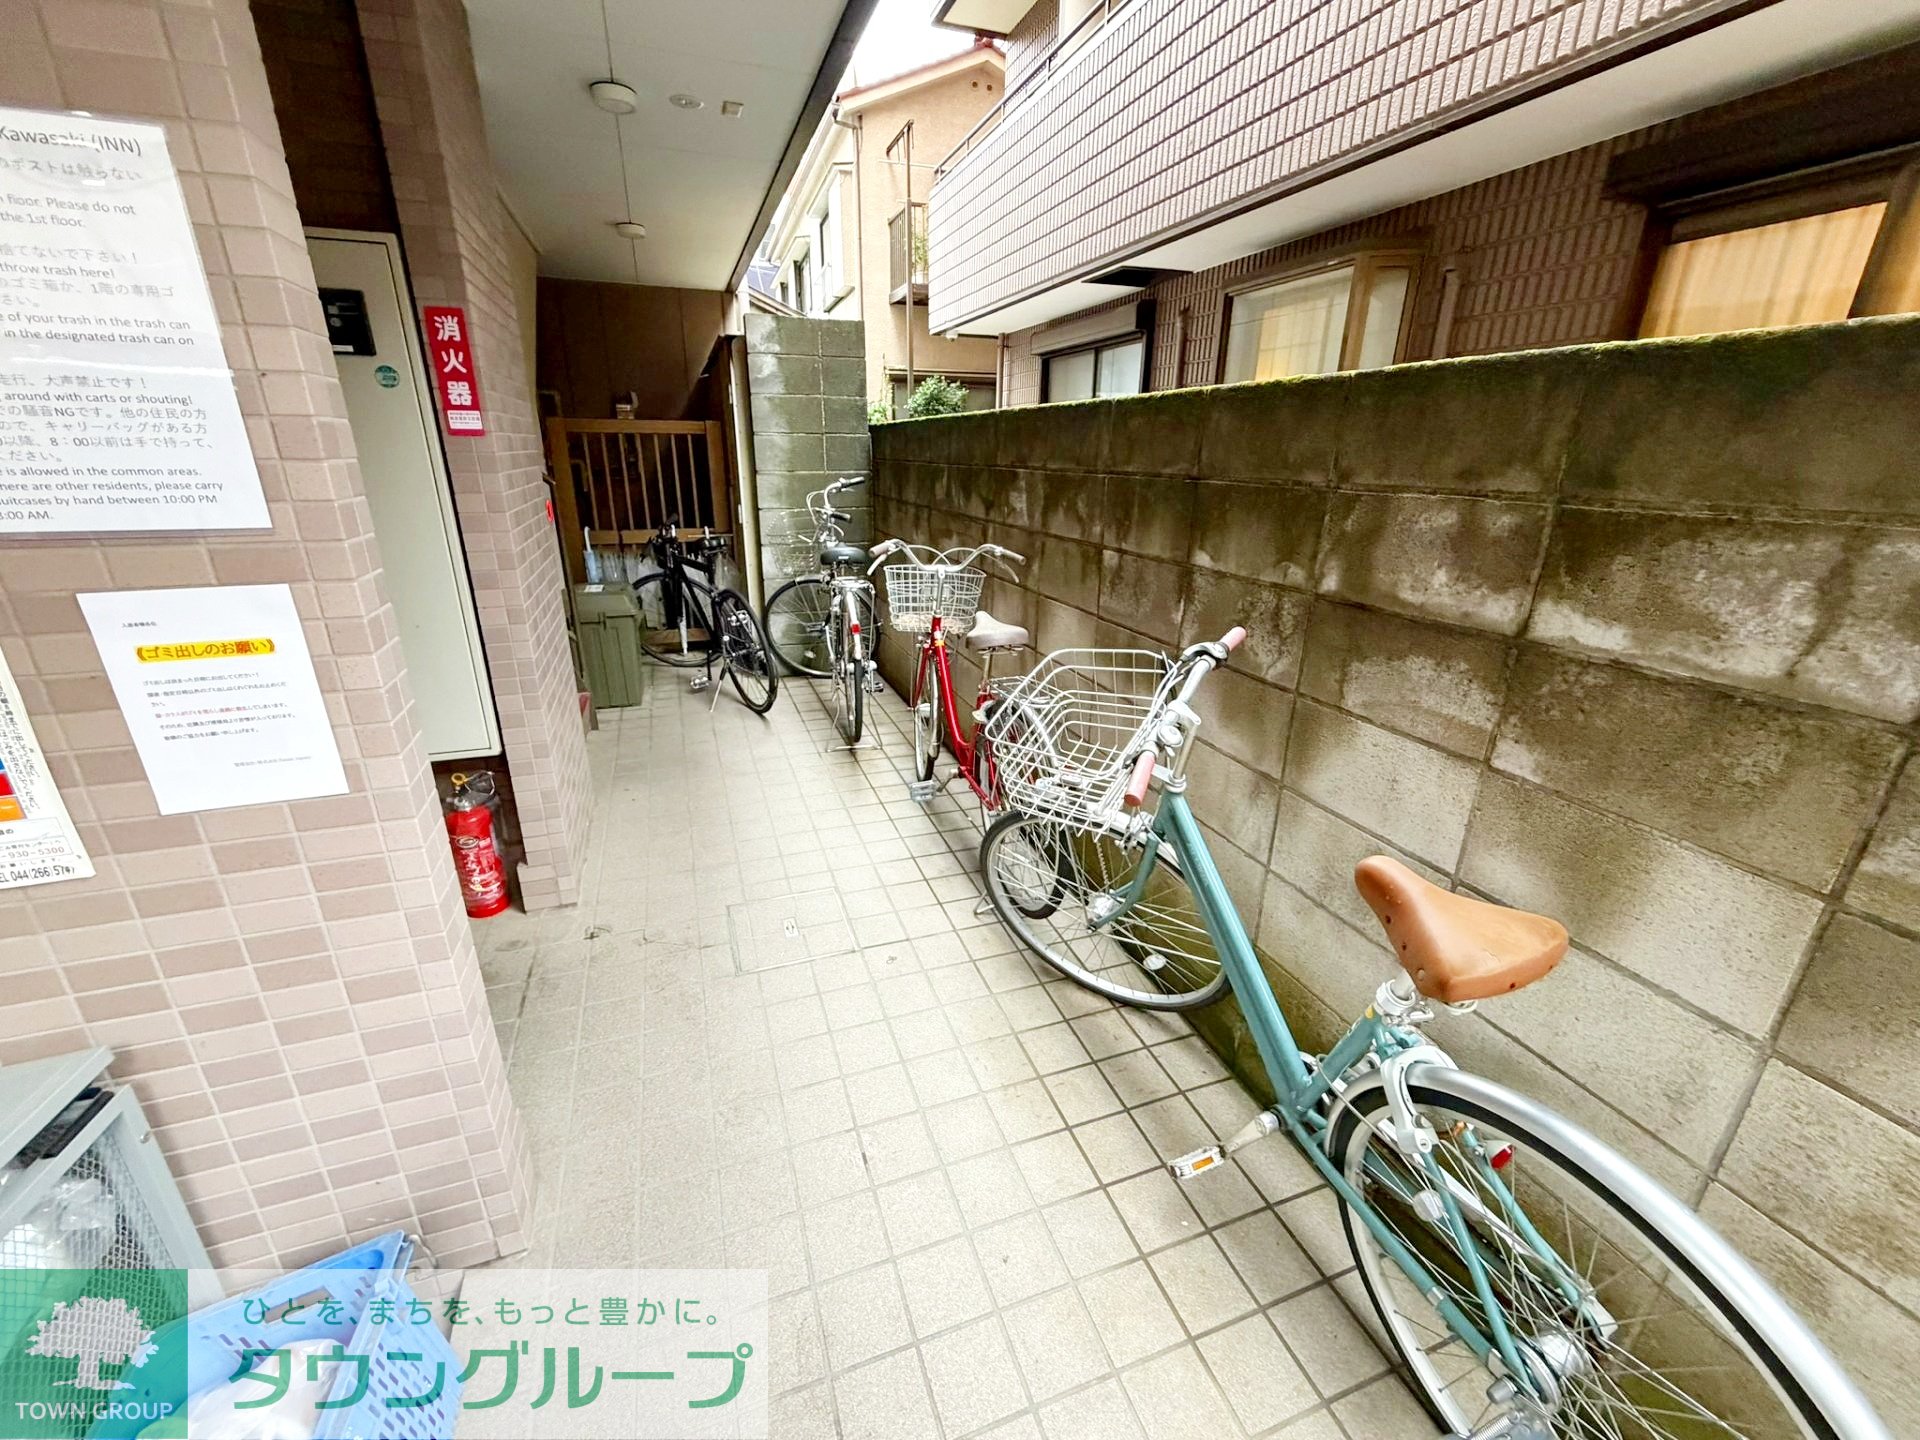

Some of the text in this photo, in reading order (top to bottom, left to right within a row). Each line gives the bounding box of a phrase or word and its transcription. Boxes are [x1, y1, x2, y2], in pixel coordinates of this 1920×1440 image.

[46, 197, 90, 212] Please
[93, 201, 110, 213] do
[113, 204, 137, 215] not
[1, 212, 25, 223] the
[29, 213, 48, 224] 1st
[43, 265, 77, 276] trash
[80, 267, 116, 279] here!
[7, 311, 21, 322] of
[25, 314, 55, 325] your
[58, 314, 92, 326] trash
[95, 317, 108, 327] in
[110, 316, 132, 328] the
[134, 318, 166, 330] trash
[169, 321, 191, 331] can
[4, 328, 195, 346] in the designated trash can on
[433, 315, 473, 406] 消火器
[4, 391, 194, 407] around with carts or shouting!
[6, 465, 202, 477] is allowed in the common areas.
[32, 482, 52, 492] are
[55, 480, 89, 491] other
[93, 480, 153, 493] residents,
[154, 481, 192, 493] please
[194, 482, 223, 493] carry
[54, 496, 70, 508] by
[73, 494, 105, 505] hand
[107, 494, 160, 505] between
[162, 494, 196, 505] 10:00
[198, 494, 218, 504] PM
